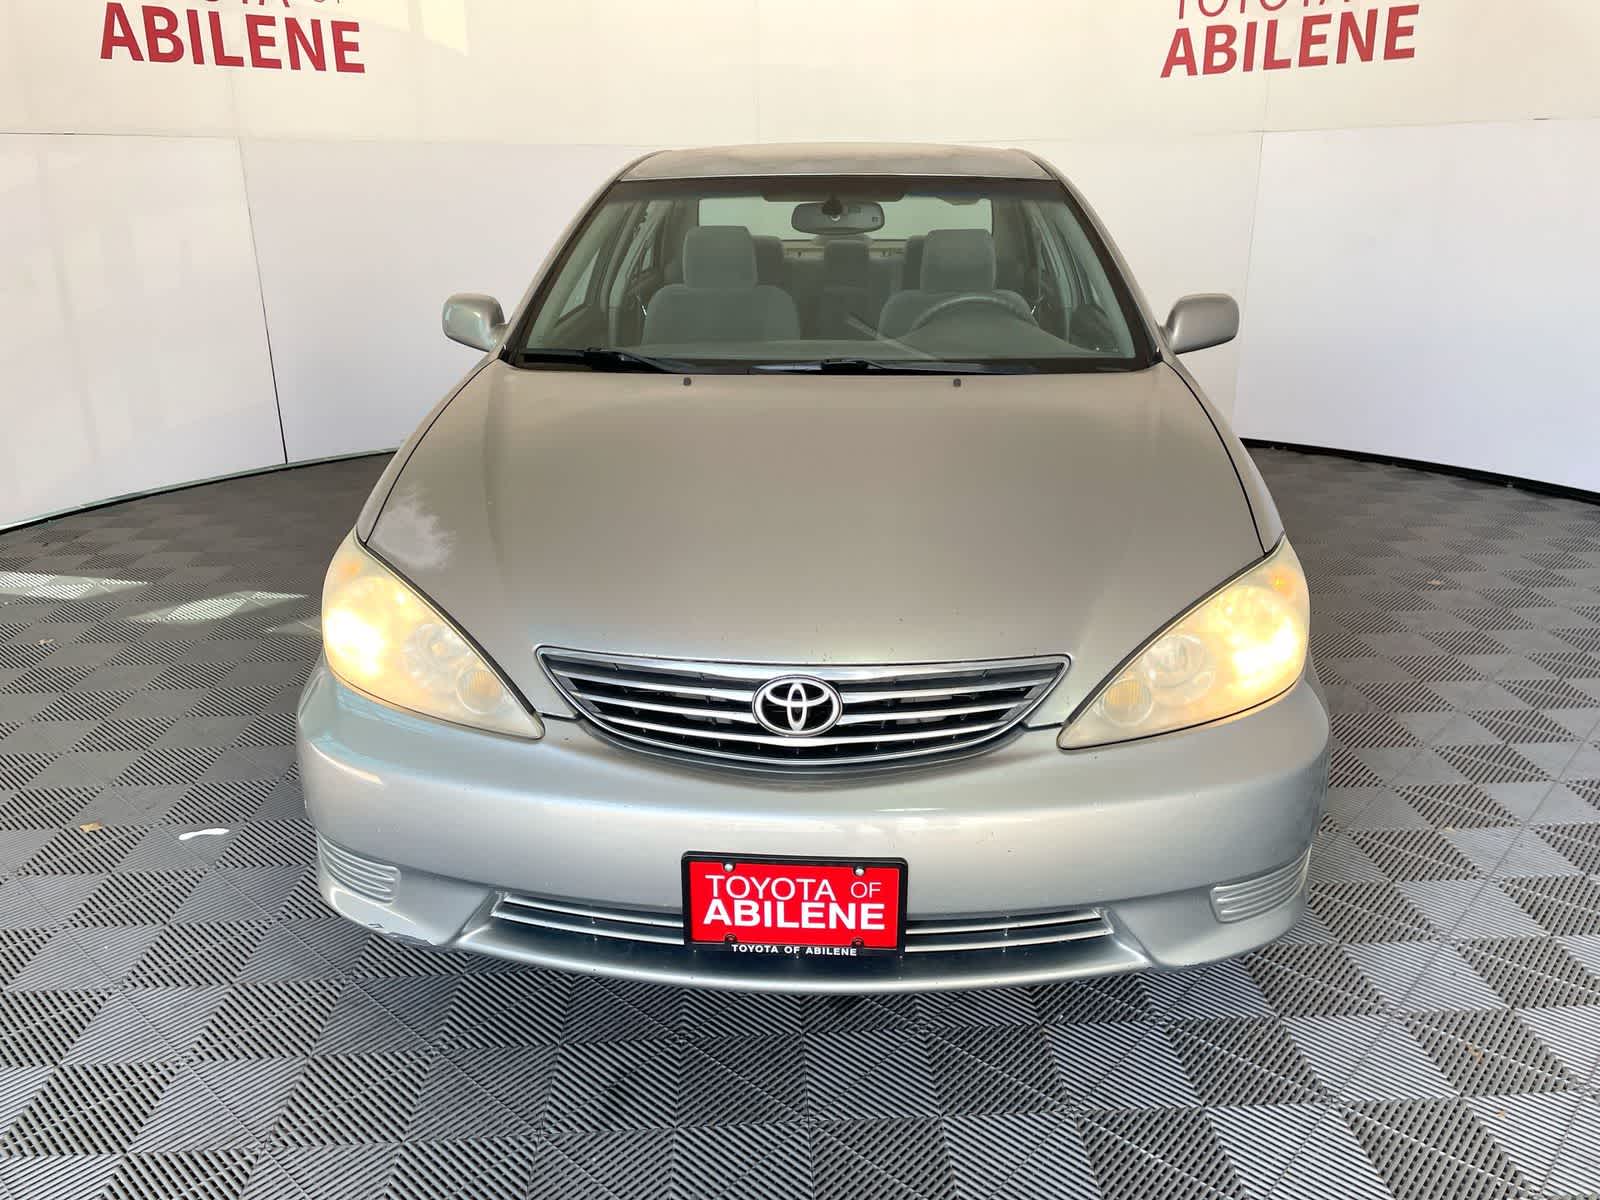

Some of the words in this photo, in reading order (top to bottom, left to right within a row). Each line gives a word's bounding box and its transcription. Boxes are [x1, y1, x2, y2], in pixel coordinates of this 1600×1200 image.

[100, 2, 366, 73] ABILENE
[1160, 4, 1420, 78] ABILENE
[704, 874, 837, 902] TOYOTA
[850, 881, 882, 899] OF
[703, 899, 886, 931] ABILENE
[731, 943, 779, 954] TOYOTA
[783, 945, 801, 954] OF
[805, 946, 857, 957] ABILENE
